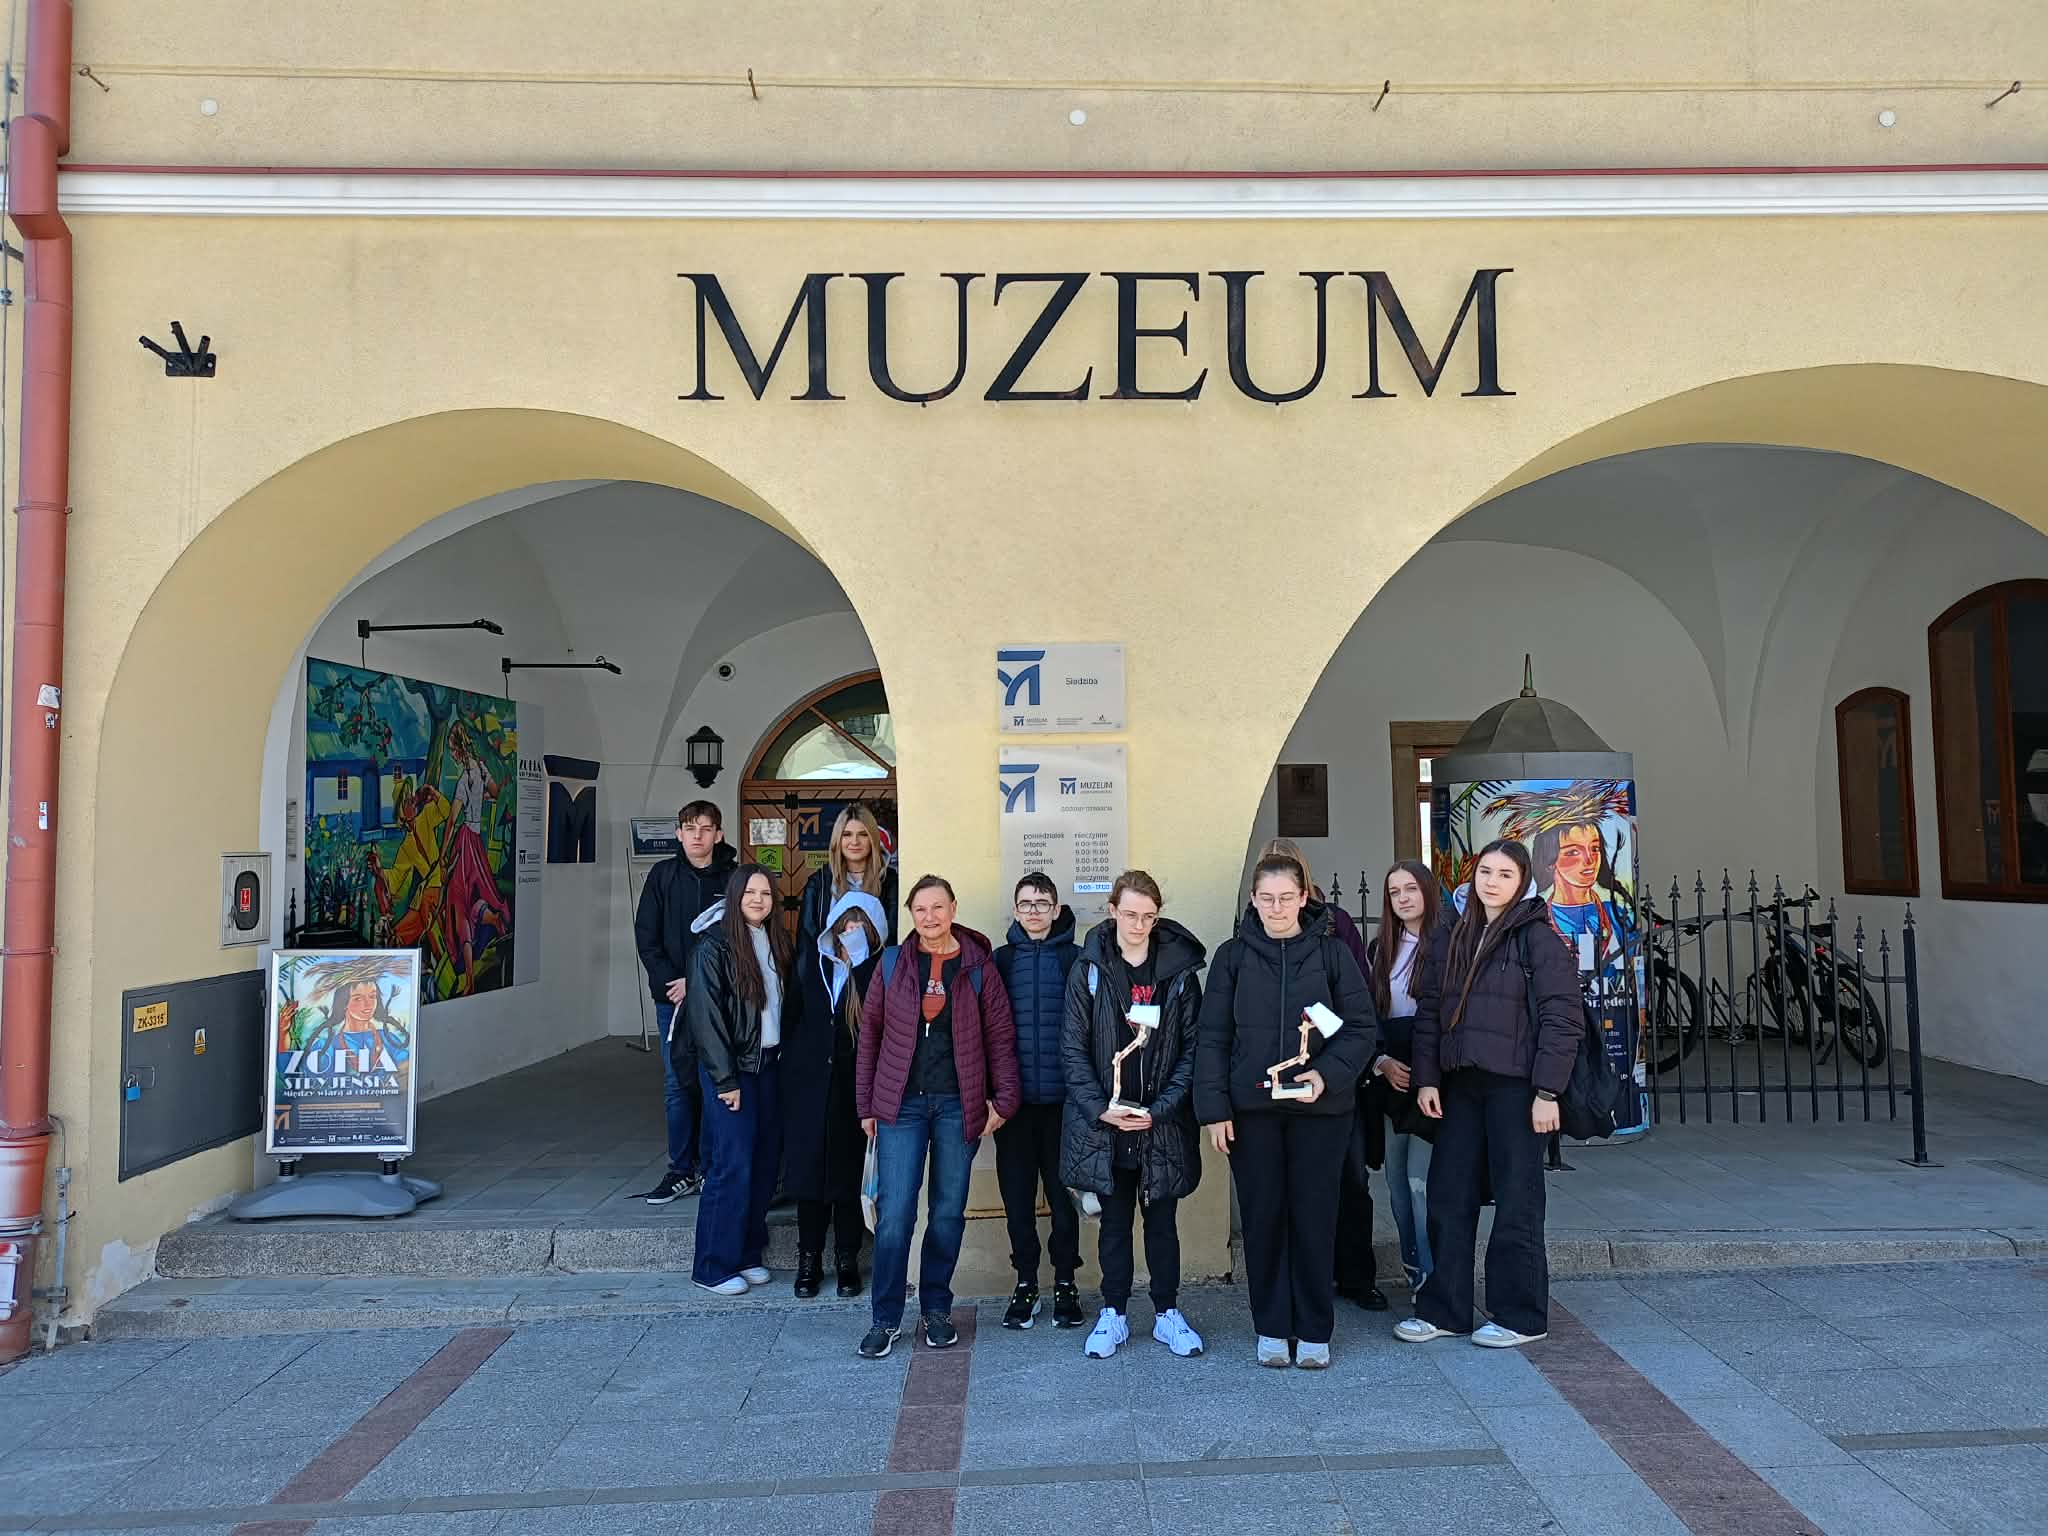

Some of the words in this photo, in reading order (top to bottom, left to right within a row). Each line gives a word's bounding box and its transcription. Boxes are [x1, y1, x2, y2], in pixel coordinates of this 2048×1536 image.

[677, 269, 1517, 402] MUZEUM
[1065, 677, 1099, 686] Siedziba
[1080, 781, 1113, 790] MUZEUM
[284, 1046, 399, 1074] ZOFIA
